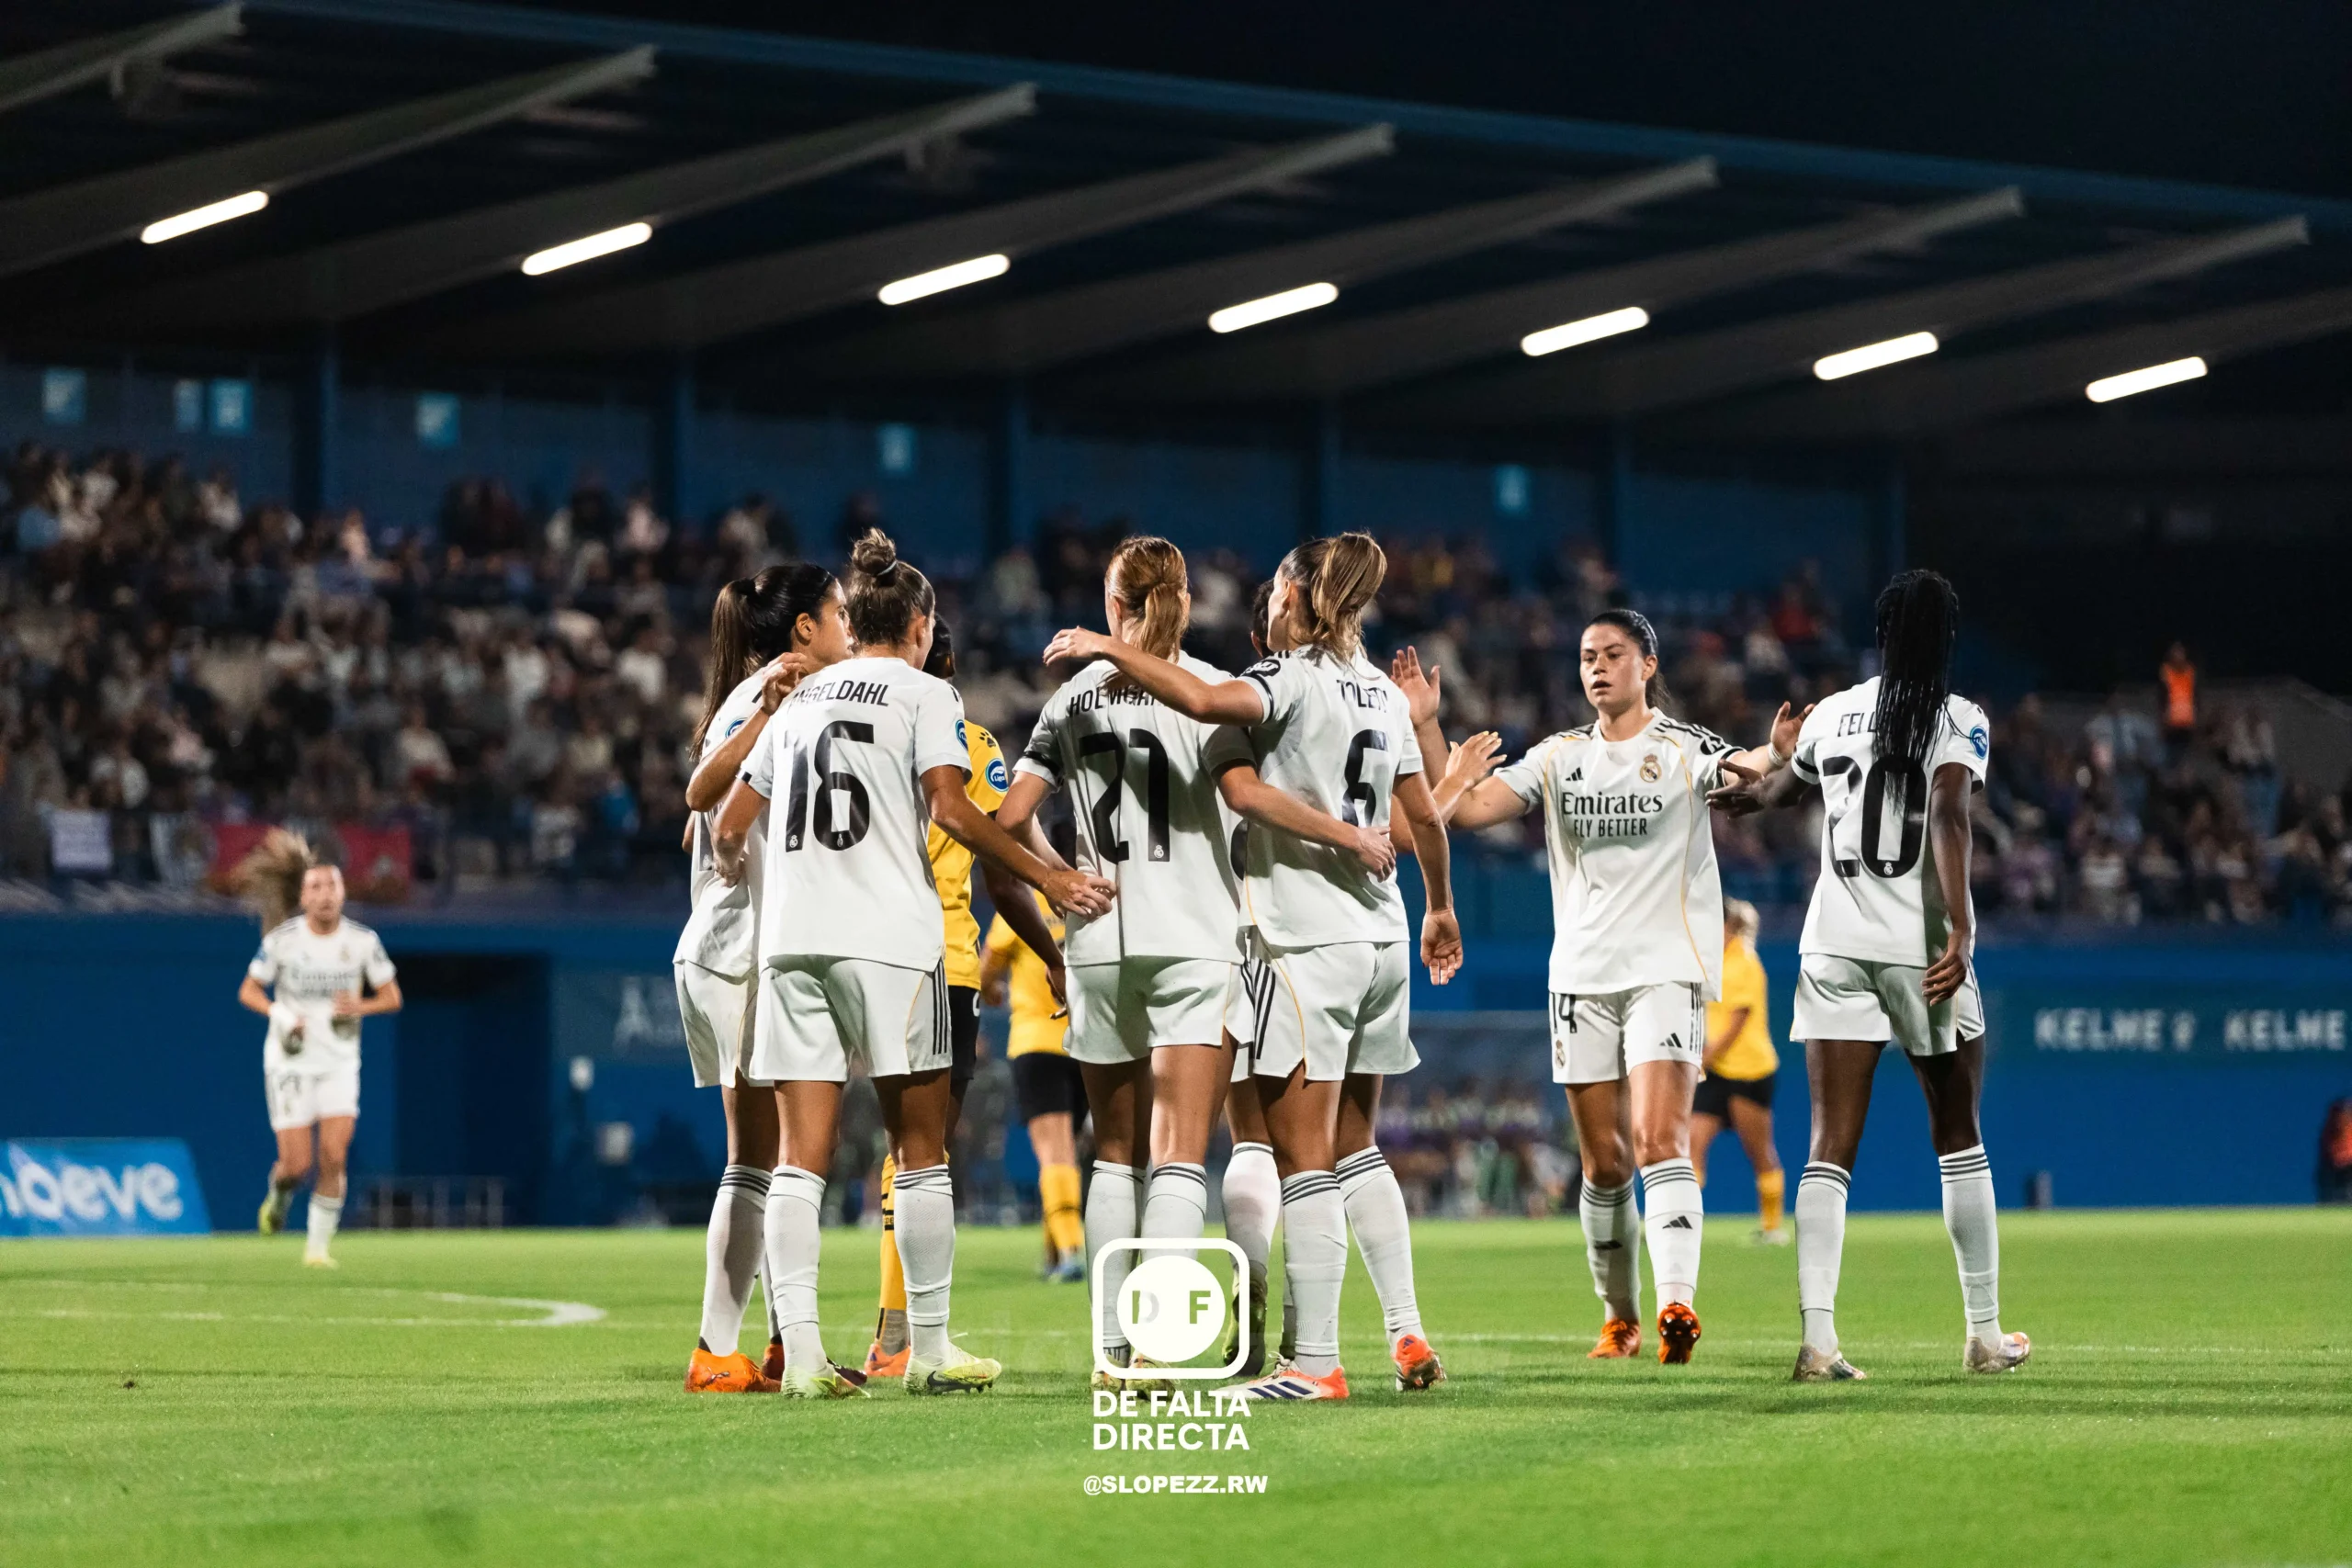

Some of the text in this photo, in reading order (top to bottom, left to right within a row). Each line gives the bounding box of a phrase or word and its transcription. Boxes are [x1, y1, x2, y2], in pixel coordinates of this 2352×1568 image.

[1838, 711, 1878, 737] FELL
[784, 720, 875, 852] 16
[1080, 728, 1170, 864] 21
[1341, 728, 1388, 828] 6
[1562, 792, 1663, 815] Emirates
[1574, 818, 1648, 838] FLY BETTER
[1823, 755, 1927, 878] 20
[2035, 1009, 2346, 1050] KELME KELME
